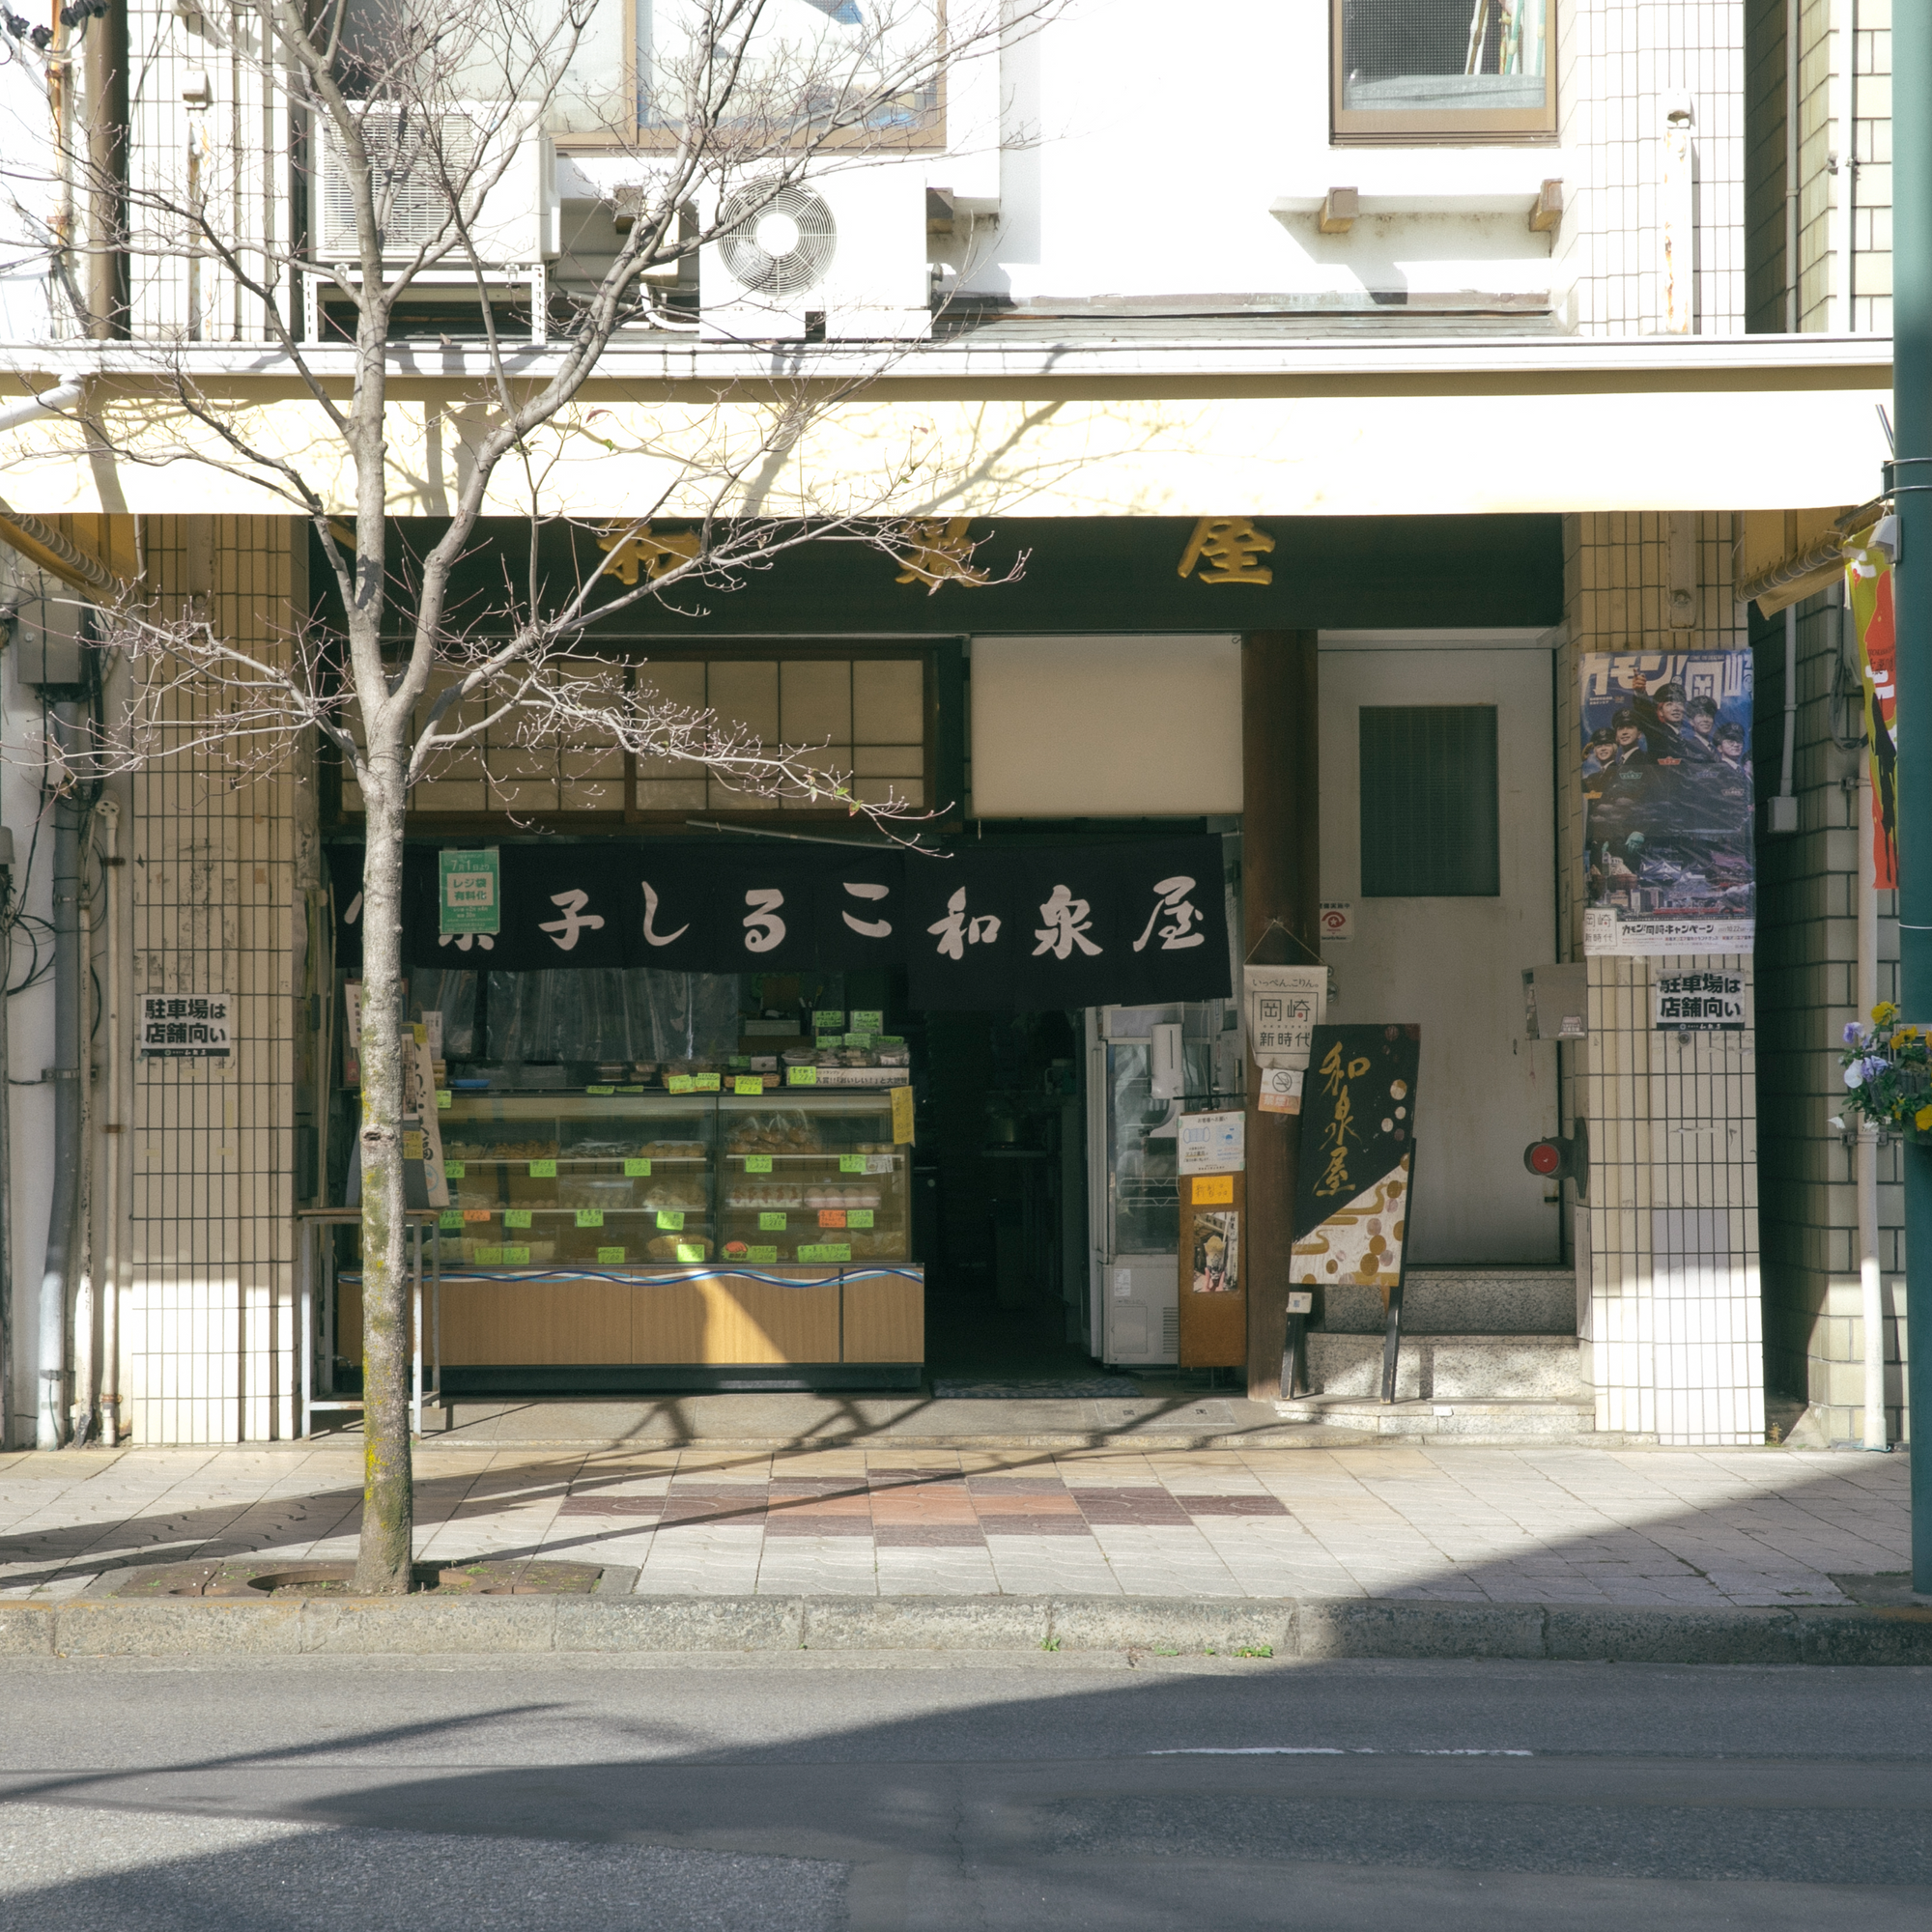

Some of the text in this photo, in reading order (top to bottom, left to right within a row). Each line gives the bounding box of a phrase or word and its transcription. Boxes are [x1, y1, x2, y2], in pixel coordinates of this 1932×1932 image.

[451, 859, 490, 871] 7月1日より
[453, 878, 487, 888] レジ袋
[454, 891, 487, 900] 有料化
[344, 875, 1205, 960] 子しるこ和泉屋
[1585, 914, 1611, 927] 岡崎
[1585, 933, 1612, 943] 新時代
[1660, 973, 1741, 993] 駐車場は
[145, 998, 226, 1019] 駐車場は
[1260, 999, 1311, 1022] 岡崎
[1661, 997, 1741, 1017] 店舗向い
[145, 1022, 226, 1043] 店舗向い
[1260, 1032, 1311, 1047] 新時代
[1312, 1040, 1371, 1197] 和泉屋
